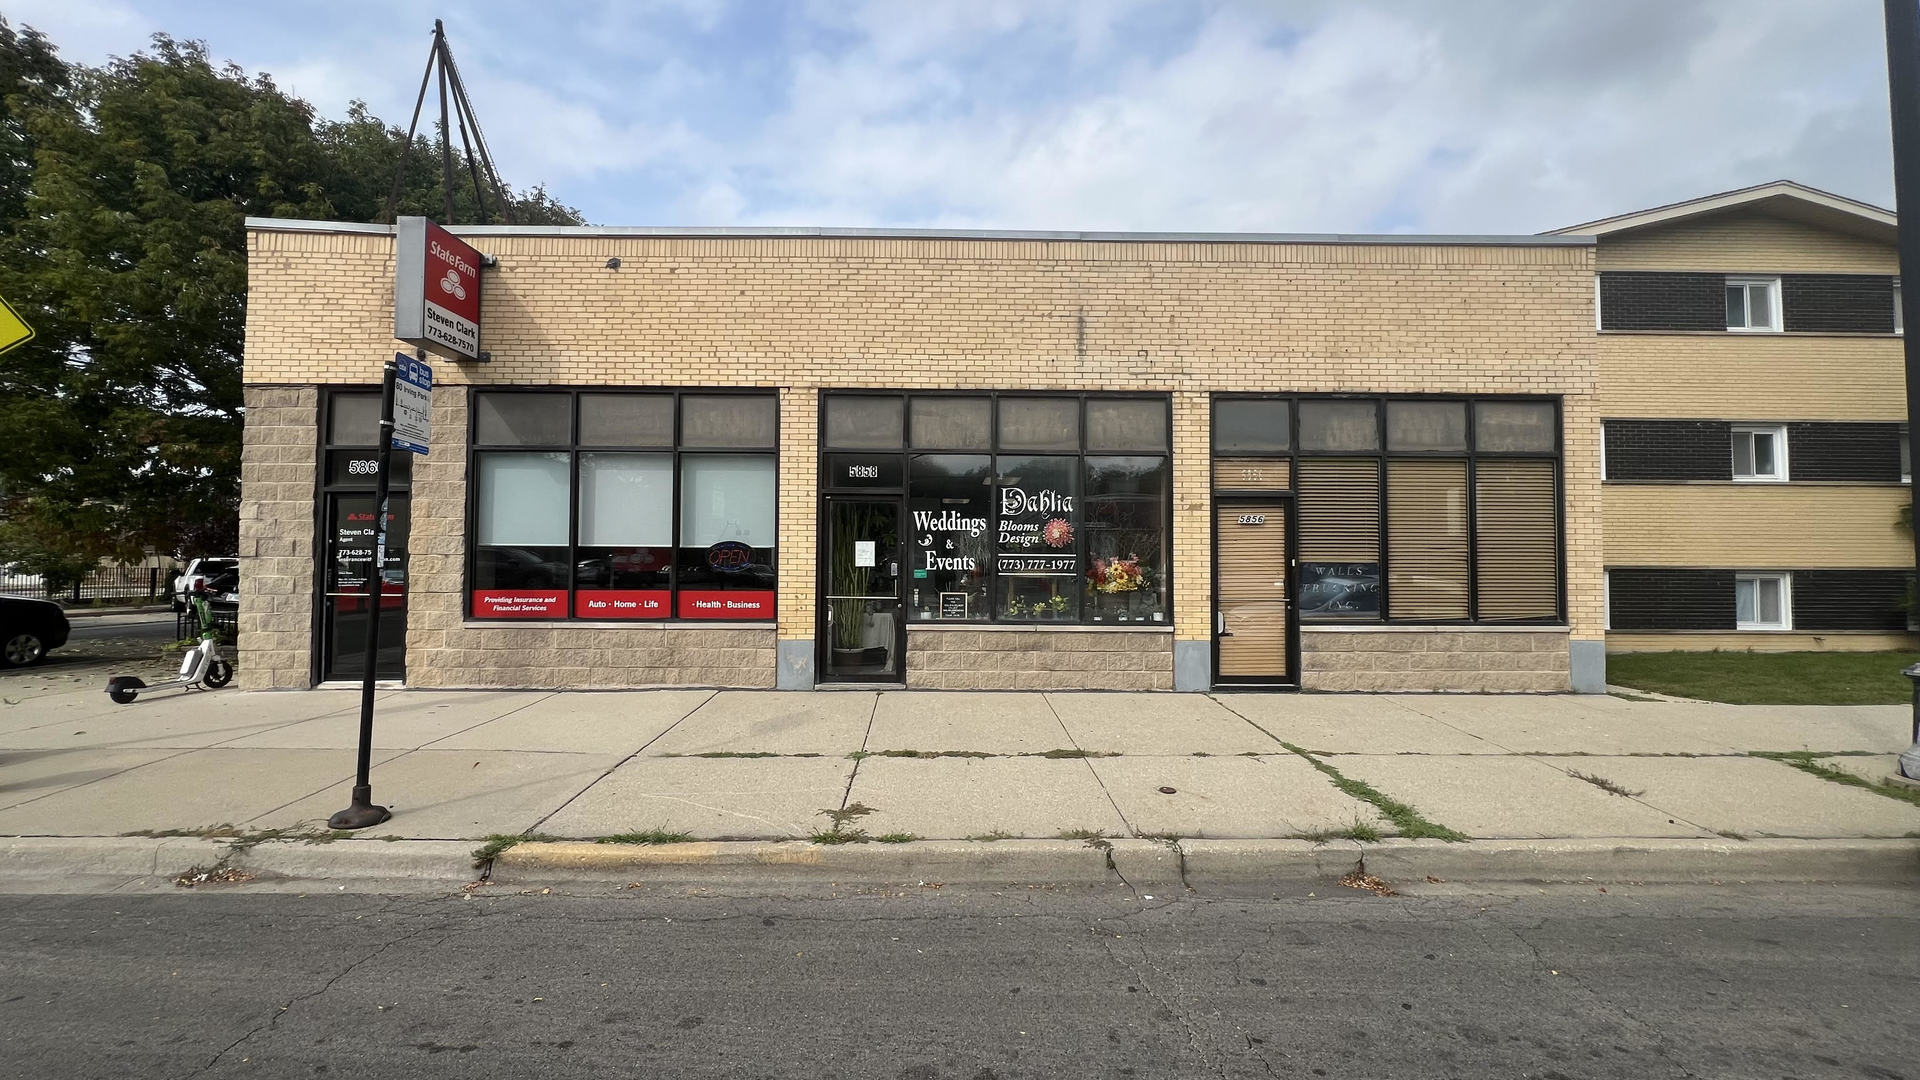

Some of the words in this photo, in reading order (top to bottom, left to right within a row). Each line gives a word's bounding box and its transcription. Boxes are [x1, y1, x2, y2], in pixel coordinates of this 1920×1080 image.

[427, 307, 454, 328] Steven
[456, 320, 476, 339] Clark
[428, 326, 475, 352] 773-628-7570
[420, 366, 429, 378] bus
[419, 376, 430, 388] stop
[404, 386, 416, 398] Irving
[418, 392, 427, 401] Park
[349, 461, 379, 474] 586
[849, 465, 878, 478] 5858
[1000, 487, 1073, 519] Dahlia
[913, 511, 987, 537] Weddings
[1239, 515, 1264, 523] 5856
[339, 528, 361, 536] Steven
[363, 528, 375, 536] Cla
[998, 520, 1039, 532] Blooms
[945, 539, 954, 549] &
[998, 533, 1039, 547] Design
[709, 550, 750, 564] OPEN
[925, 551, 976, 571] Events
[997, 559, 1025, 571] (773)
[1027, 559, 1076, 570] 777-1977
[1315, 567, 1363, 576] WALLS
[1303, 584, 1378, 593] TRUCKING
[484, 596, 512, 604] Providing
[588, 600, 607, 608] Auto
[614, 600, 637, 608] Home
[644, 600, 659, 608] Life
[696, 600, 721, 608] Health
[727, 600, 761, 608] Business
[1328, 601, 1359, 609] INC.
